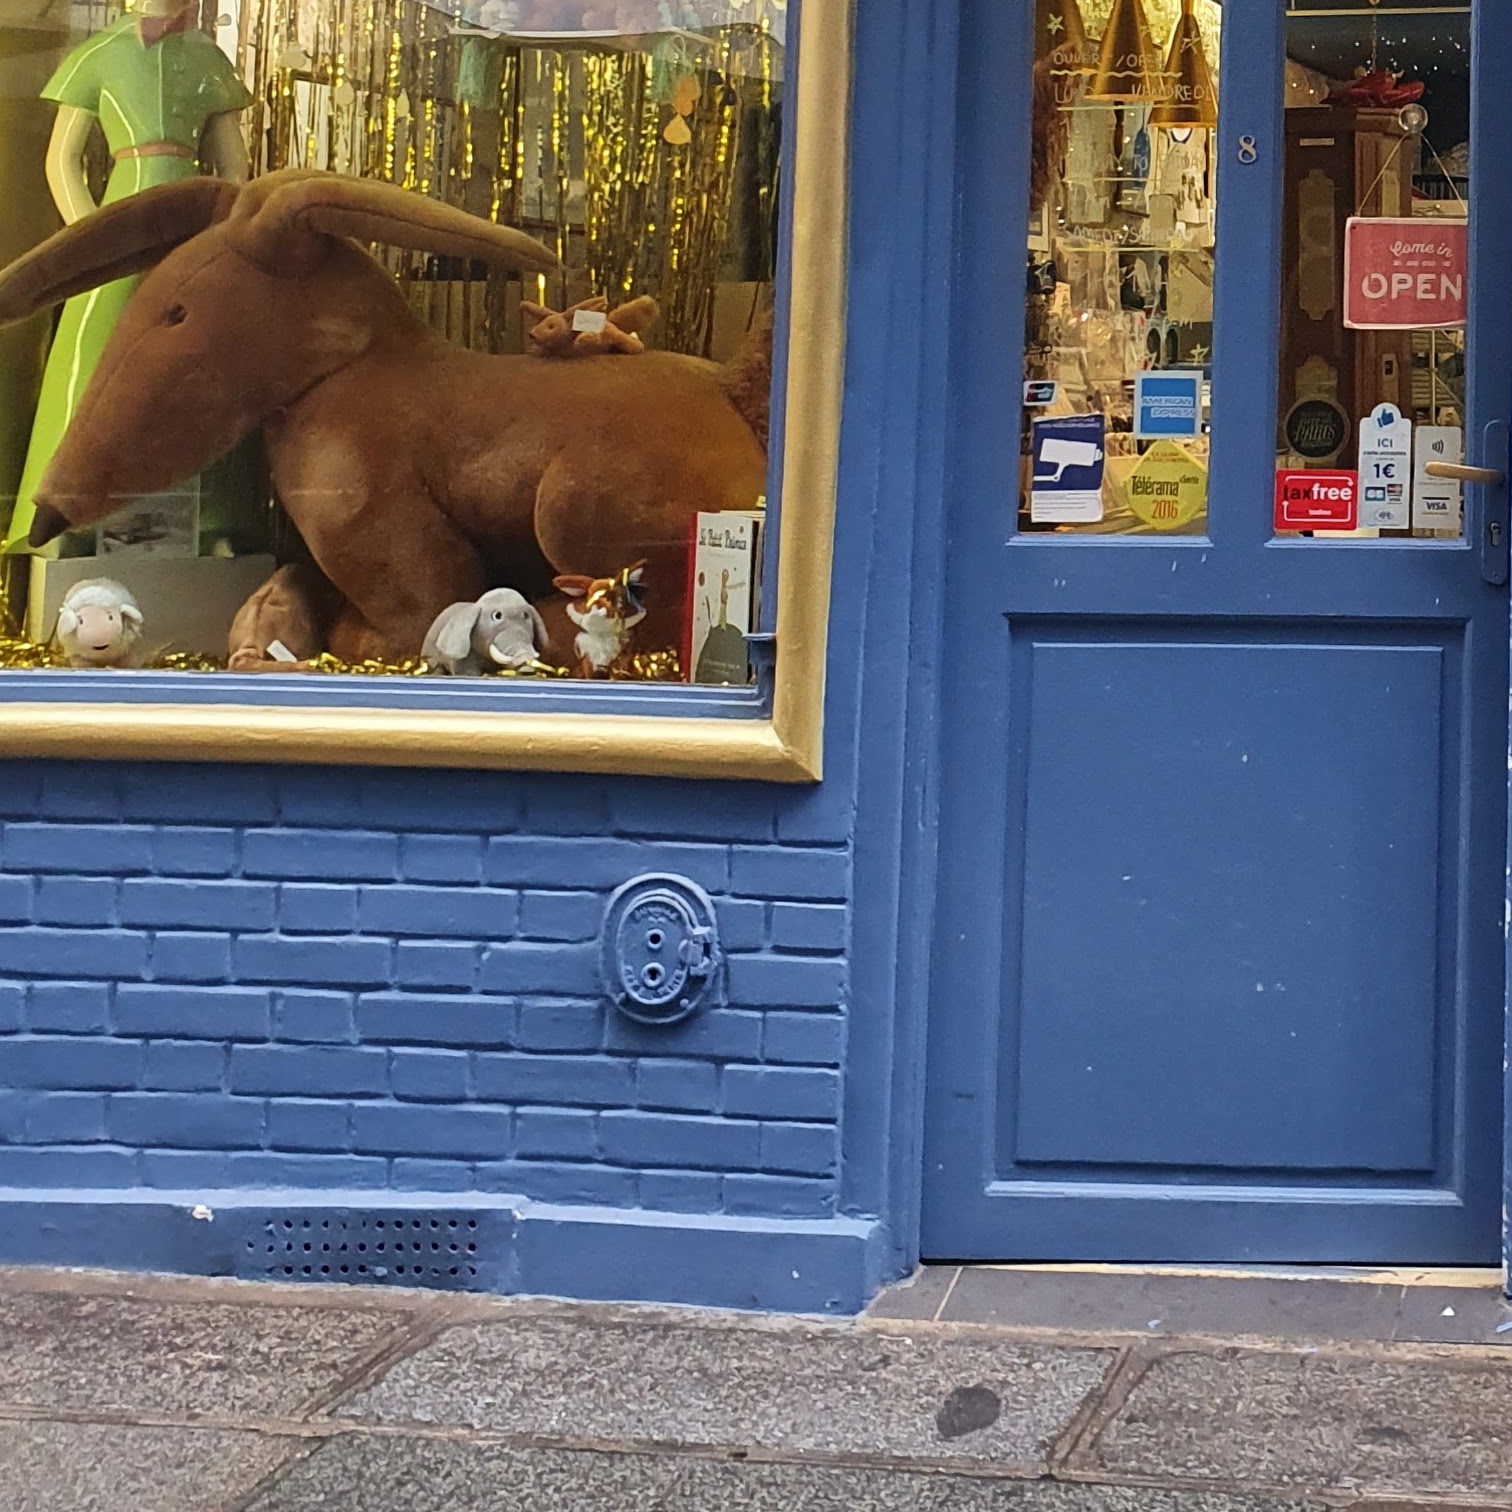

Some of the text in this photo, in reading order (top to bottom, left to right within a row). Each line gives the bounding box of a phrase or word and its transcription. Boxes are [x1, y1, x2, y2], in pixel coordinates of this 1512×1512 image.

[1237, 135, 1257, 164] 8
[1389, 240, 1453, 257] Come in
[1361, 272, 1463, 301] OPEN
[1377, 438, 1393, 448] ICI
[1373, 463, 1396, 479] 1€
[1131, 475, 1179, 497] Télérama
[1151, 499, 1178, 519] 2016
[1426, 502, 1447, 510] VISA
